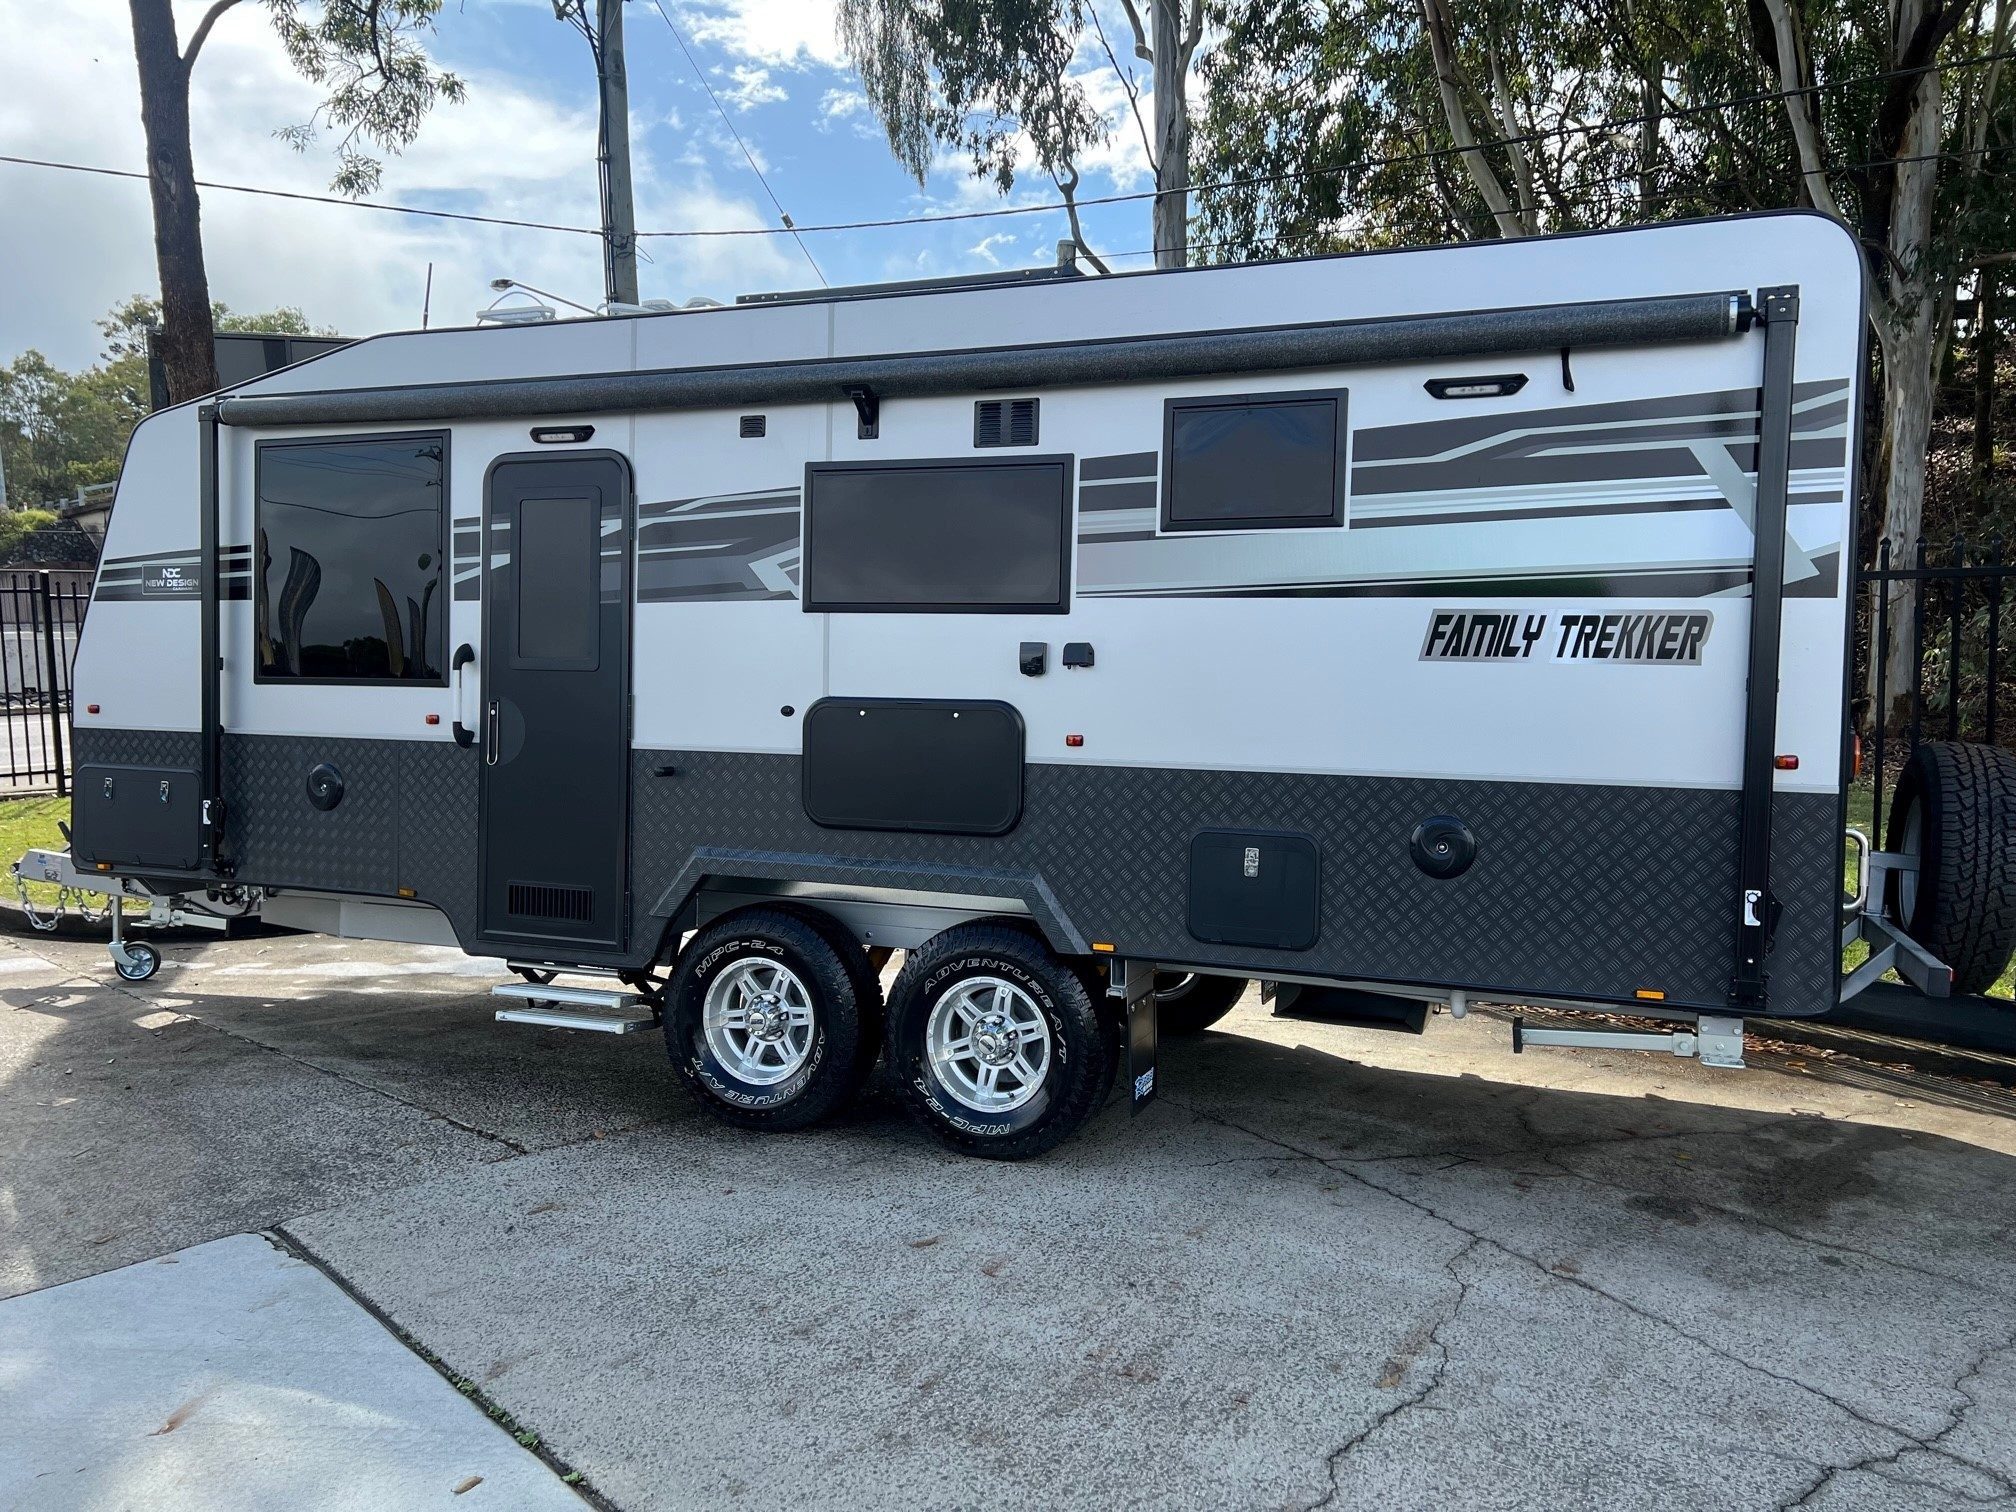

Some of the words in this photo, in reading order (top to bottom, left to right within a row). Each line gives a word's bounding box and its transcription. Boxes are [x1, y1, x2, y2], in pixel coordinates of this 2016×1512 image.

[145, 579, 165, 587] NEW
[167, 579, 199, 587] DESIGN
[163, 568, 181, 578] NDC
[1425, 614, 1547, 658] FAMILY
[1556, 615, 1708, 660] TREKKER
[695, 939, 784, 978] MPC-24
[925, 958, 1054, 1008] ADVENTURE
[725, 1026, 825, 1105] ADVENTURE
[913, 1077, 1011, 1135] MPC-24
